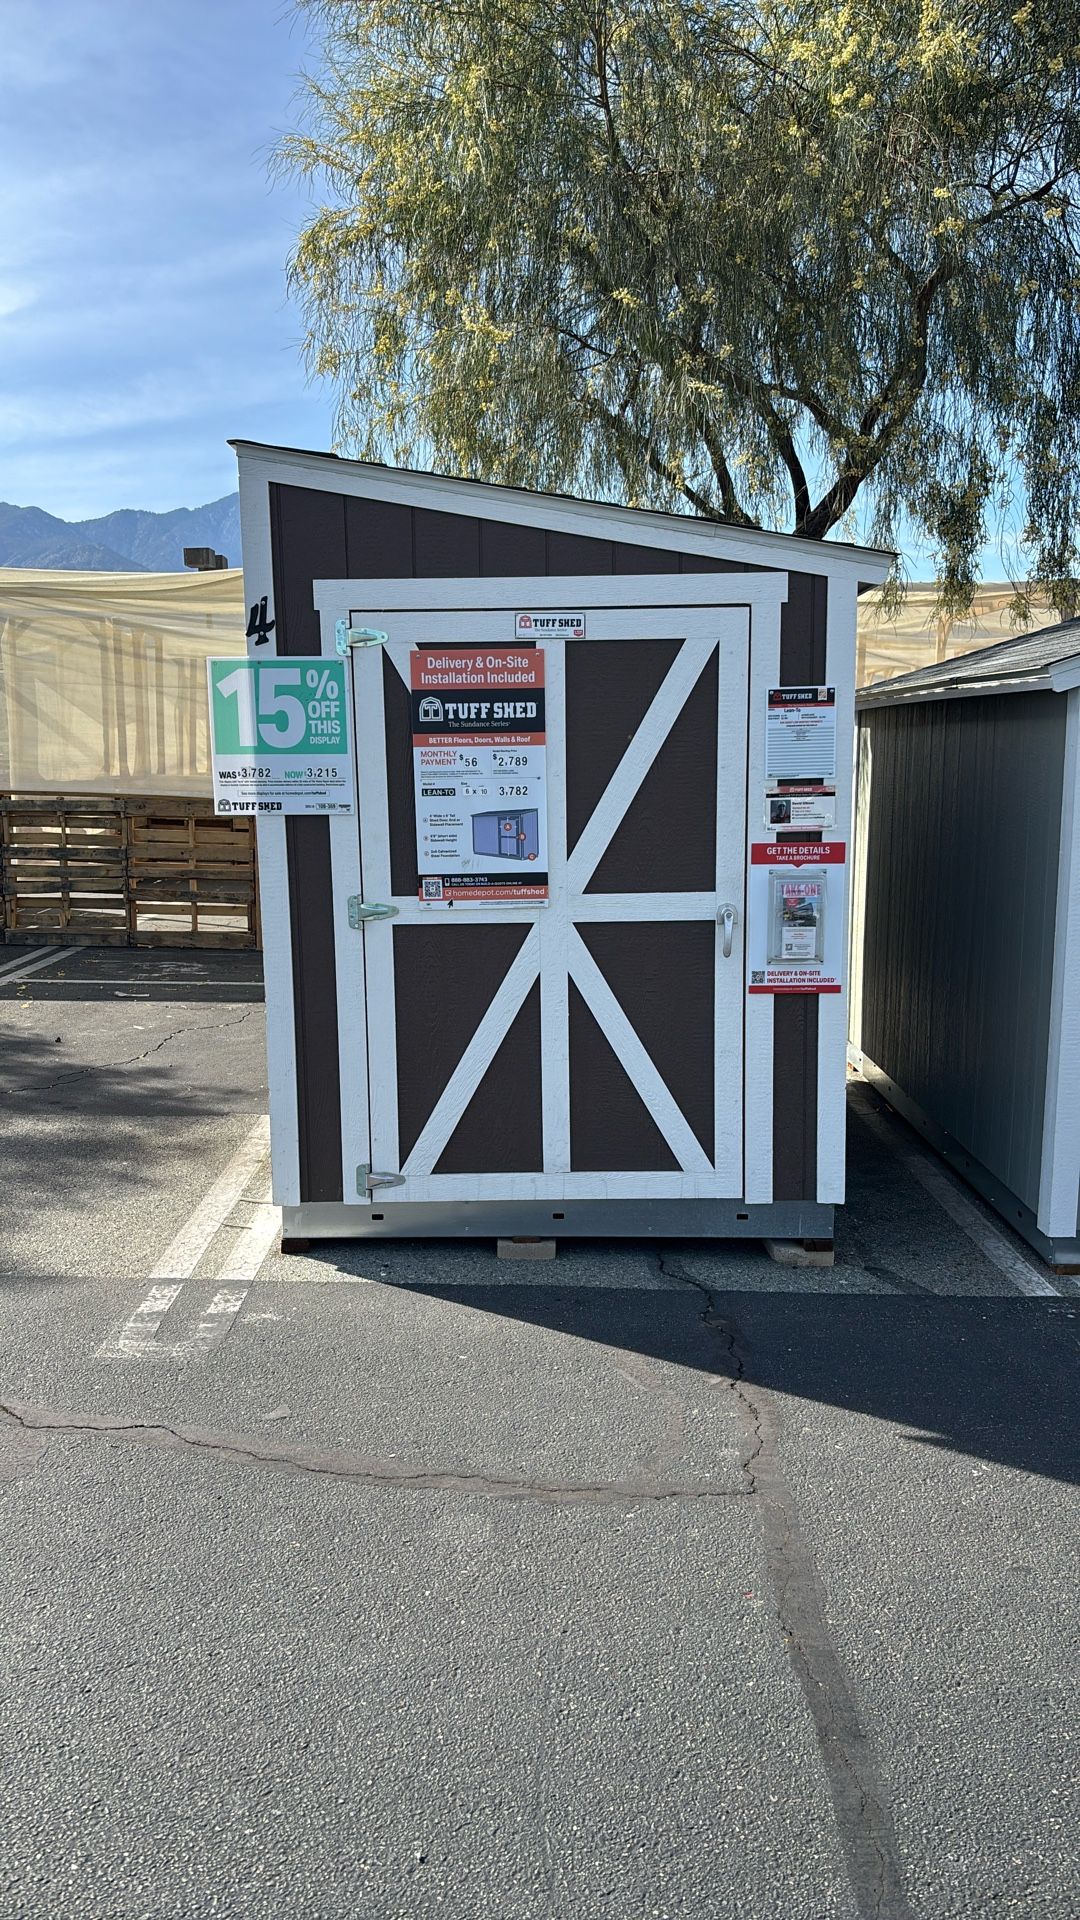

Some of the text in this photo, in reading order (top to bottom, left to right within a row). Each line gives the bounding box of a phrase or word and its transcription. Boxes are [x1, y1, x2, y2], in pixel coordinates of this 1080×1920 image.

[246, 596, 275, 646] 4
[533, 618, 581, 627] TUFF SHED
[427, 656, 528, 671] Delivery & On-Site
[421, 671, 535, 684] Installation Included
[308, 701, 340, 718] OFF
[445, 702, 536, 719] TUFF SHED
[309, 720, 340, 734] THIS
[310, 736, 340, 744] DISPLAY
[219, 771, 236, 779] WAS
[285, 771, 303, 779] NOW
[499, 786, 528, 796] 3,782
[232, 802, 282, 810] TUFF SHED
[453, 888, 544, 897] homedepot.com/tuffshed
[781, 884, 821, 896] TAKE ONE
